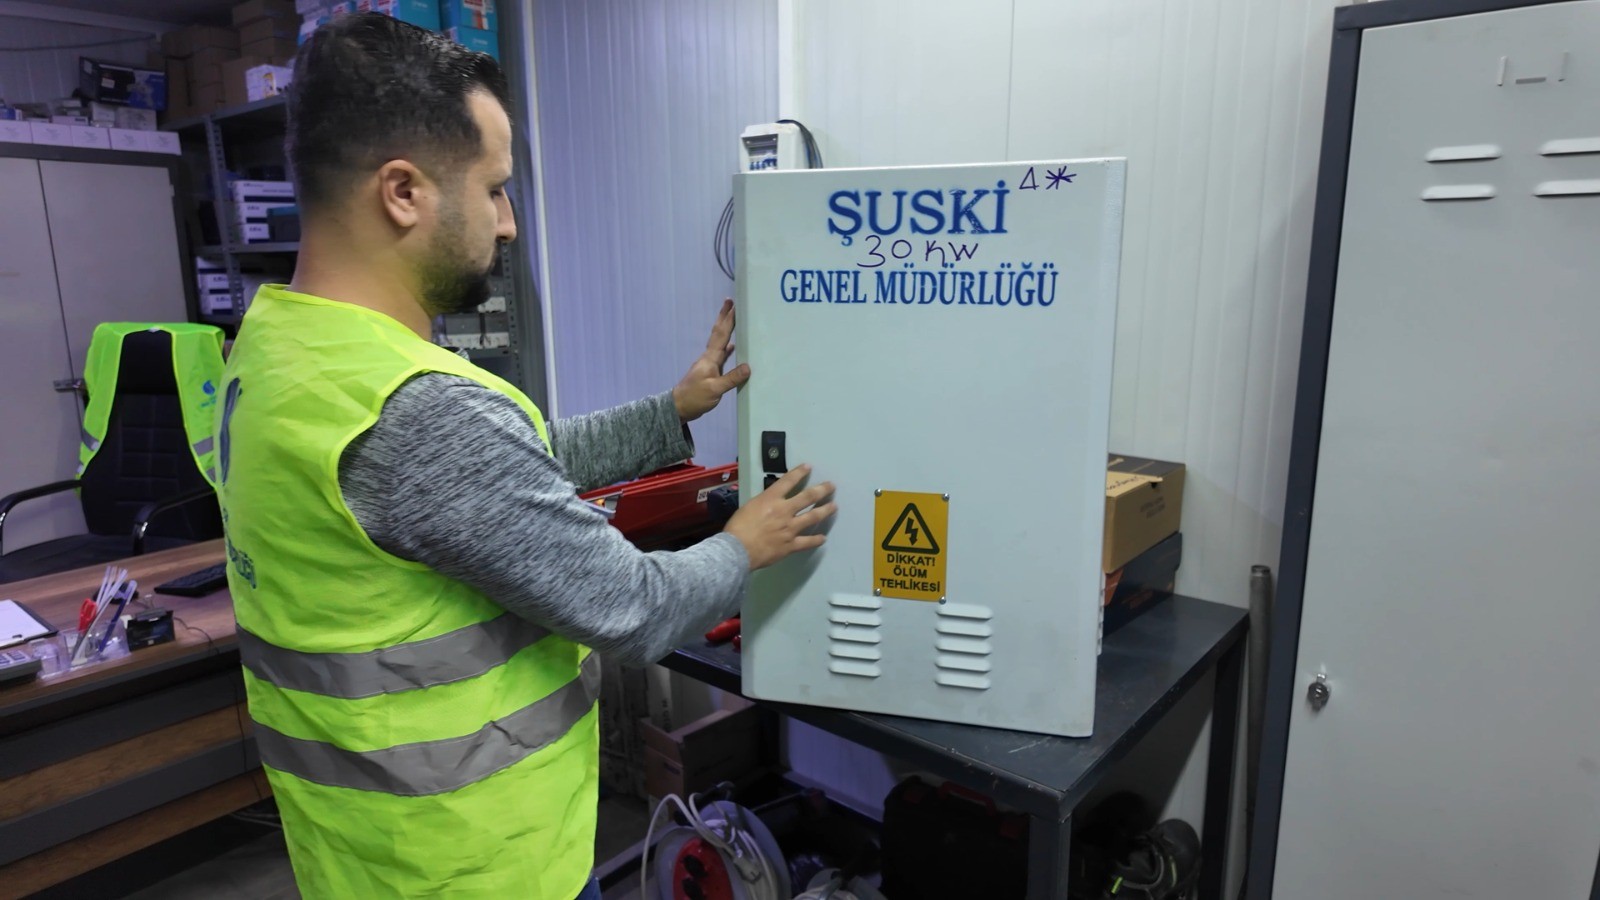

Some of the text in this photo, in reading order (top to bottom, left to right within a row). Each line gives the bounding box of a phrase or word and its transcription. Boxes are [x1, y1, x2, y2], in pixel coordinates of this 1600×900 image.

[827, 179, 1011, 247] ŞUSKİ
[857, 234, 913, 268] 30
[780, 261, 1060, 308] GENEL MÜDÜRLÜĞÜ
[886, 552, 936, 567] DİKKAT!
[893, 565, 928, 578] ÖLÜM
[879, 577, 941, 592] TEHLİKESİ
